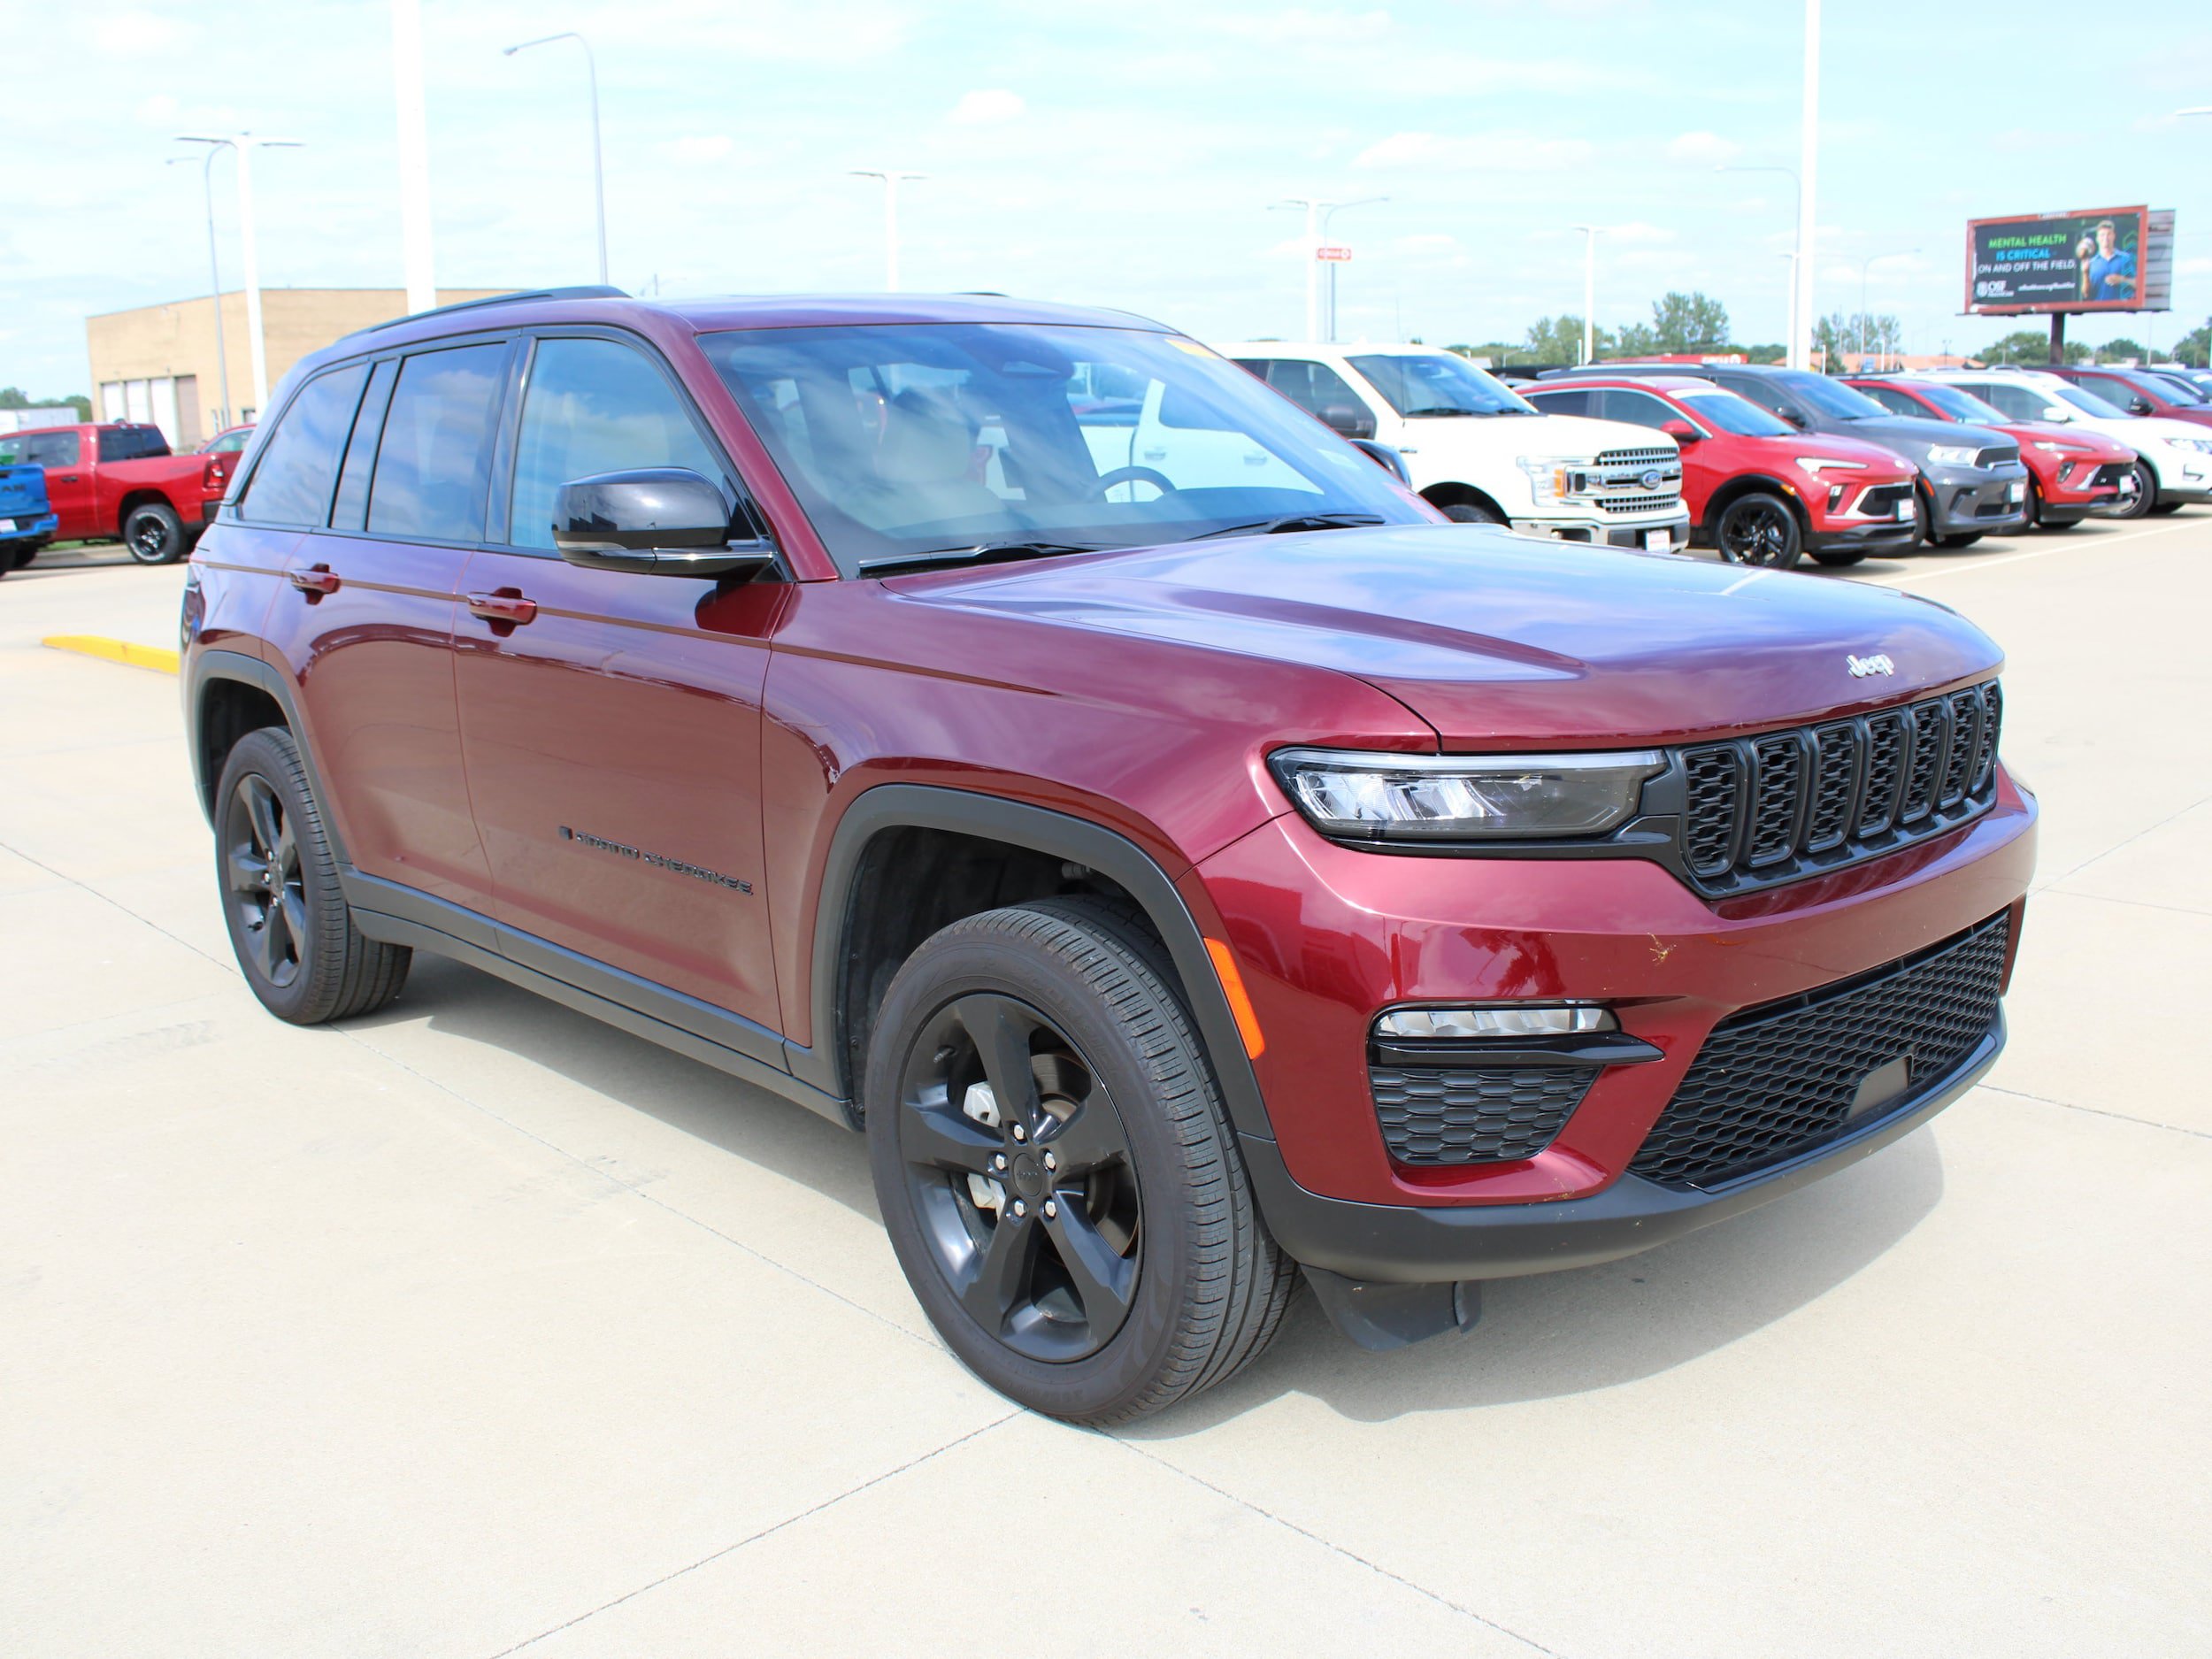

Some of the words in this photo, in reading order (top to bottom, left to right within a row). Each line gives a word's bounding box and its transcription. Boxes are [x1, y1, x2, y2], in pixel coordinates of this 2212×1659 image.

[1988, 237, 2026, 248] MENTAL
[2029, 234, 2067, 245] HEALTH
[1996, 251, 2005, 261] IS
[2008, 249, 2050, 260] CRITICAL
[1993, 263, 2012, 273] AND
[2014, 262, 2031, 272] OFF
[2032, 260, 2048, 271] THE
[1846, 654, 1894, 679] Jeep
